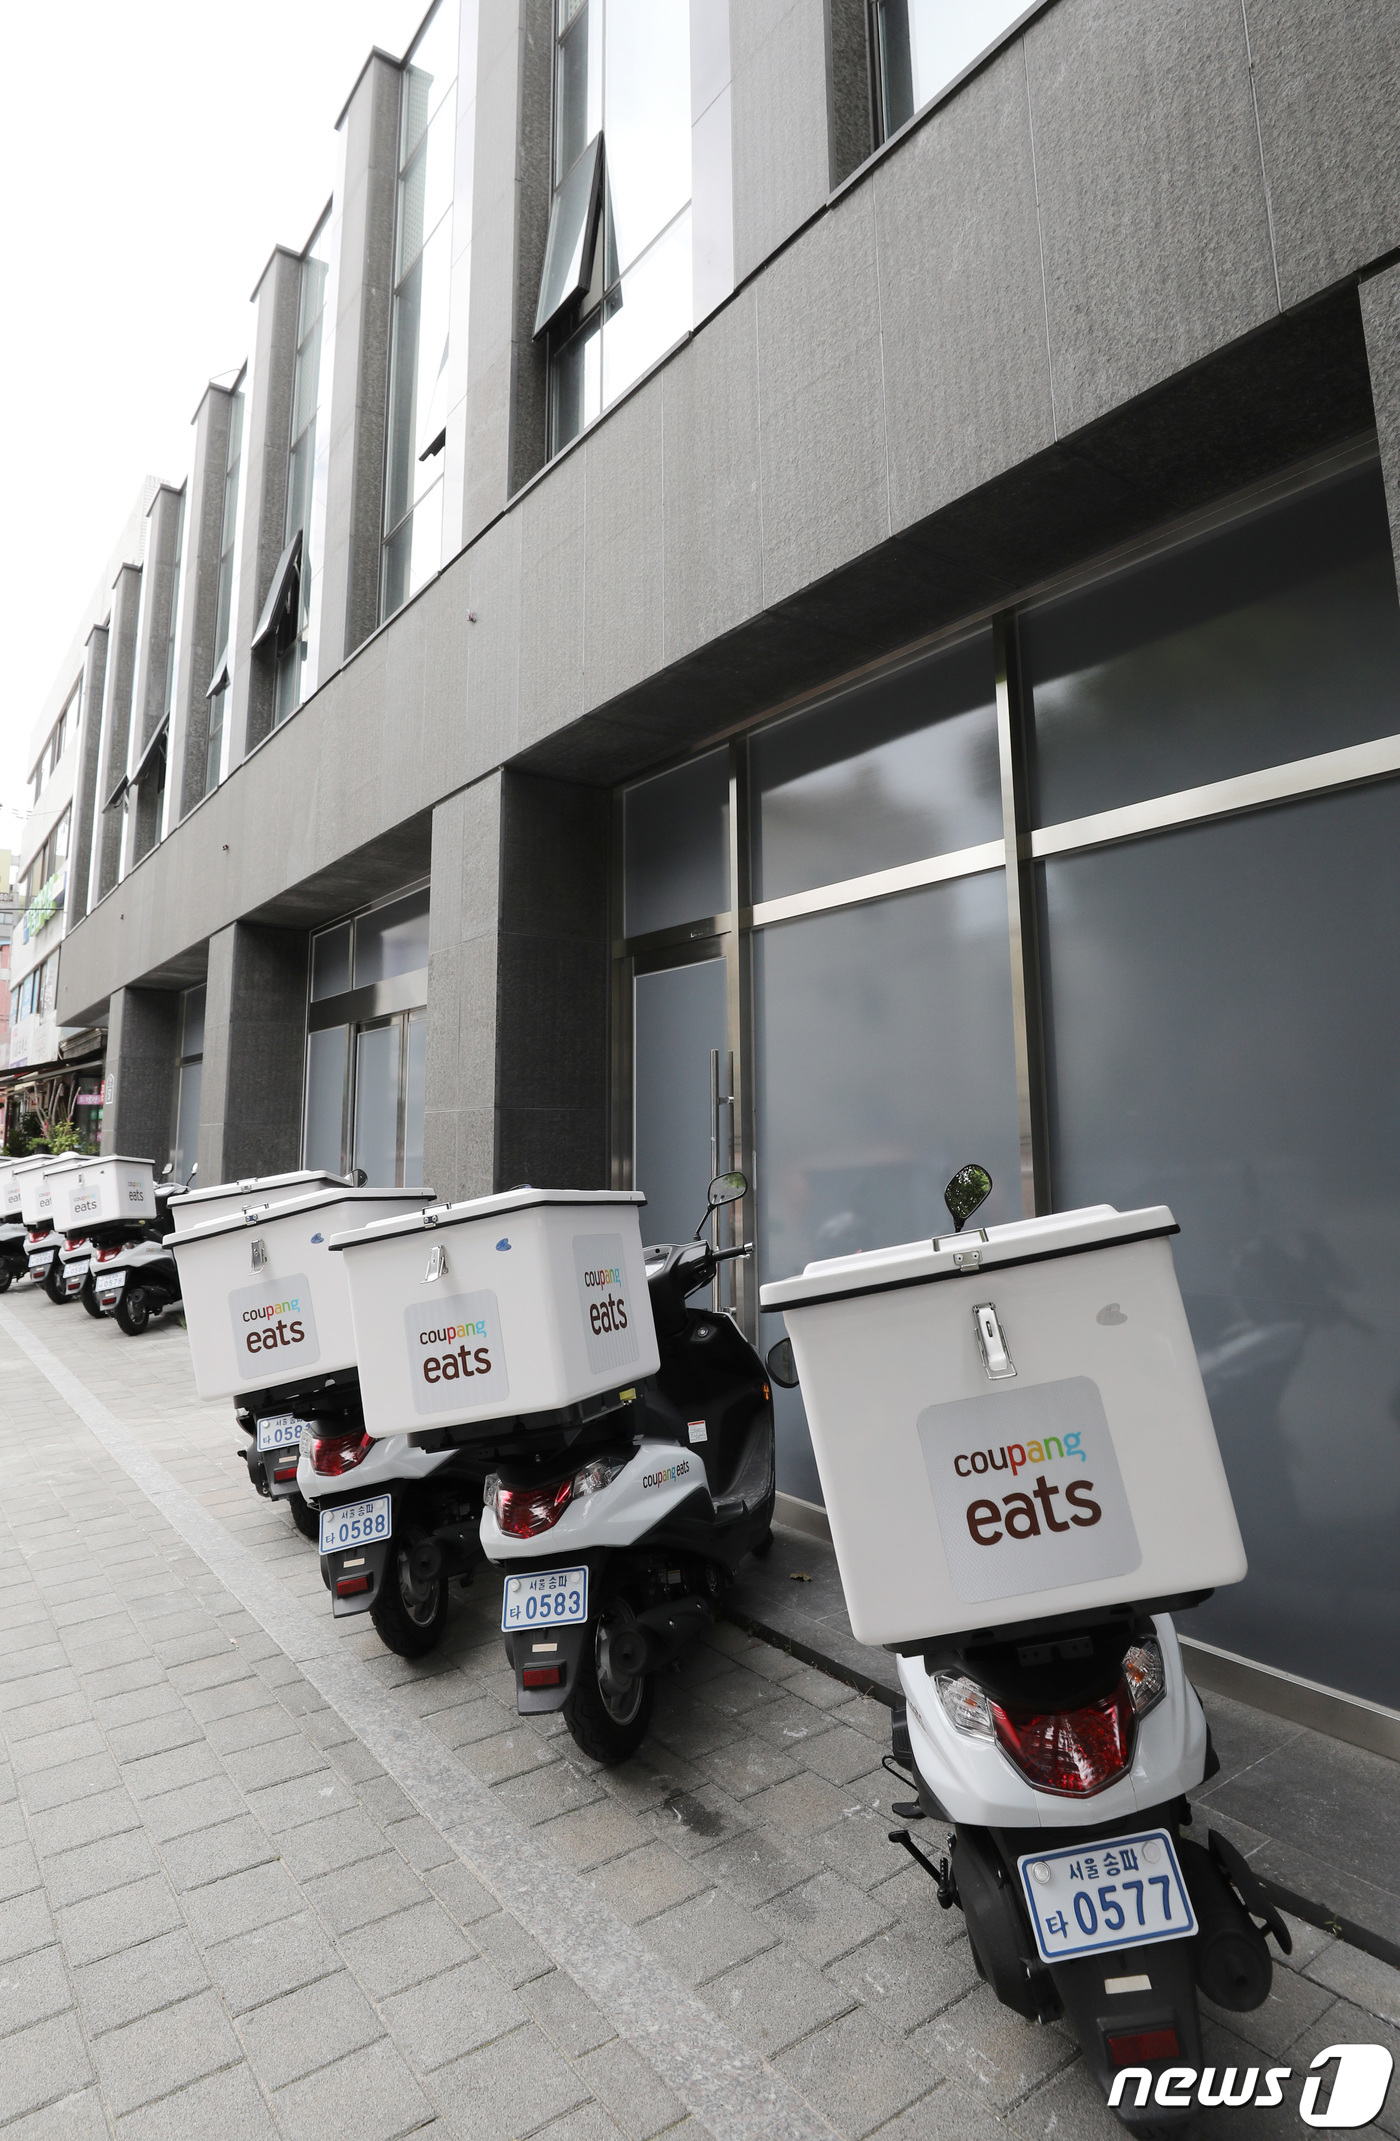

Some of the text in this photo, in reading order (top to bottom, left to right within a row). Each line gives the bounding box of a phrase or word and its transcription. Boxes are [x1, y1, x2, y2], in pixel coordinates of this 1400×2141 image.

[74, 1200, 98, 1213] eats
[128, 1190, 144, 1201] eats
[584, 1266, 622, 1290] coupang
[242, 1298, 301, 1323] coupang
[589, 1293, 628, 1335] eats
[246, 1319, 305, 1353] eats
[419, 1320, 487, 1345] coupang
[423, 1344, 492, 1384] eats
[954, 1431, 1087, 1477] coupang
[642, 1459, 690, 1489] coupang eats
[966, 1475, 1102, 1546] eats
[325, 1514, 385, 1544] 타 0588
[529, 1575, 568, 1591] 서울 송파
[509, 1590, 581, 1620] 타 0583
[1069, 1848, 1139, 1880] 서울 송파
[1045, 1875, 1172, 1939] 타 0577
